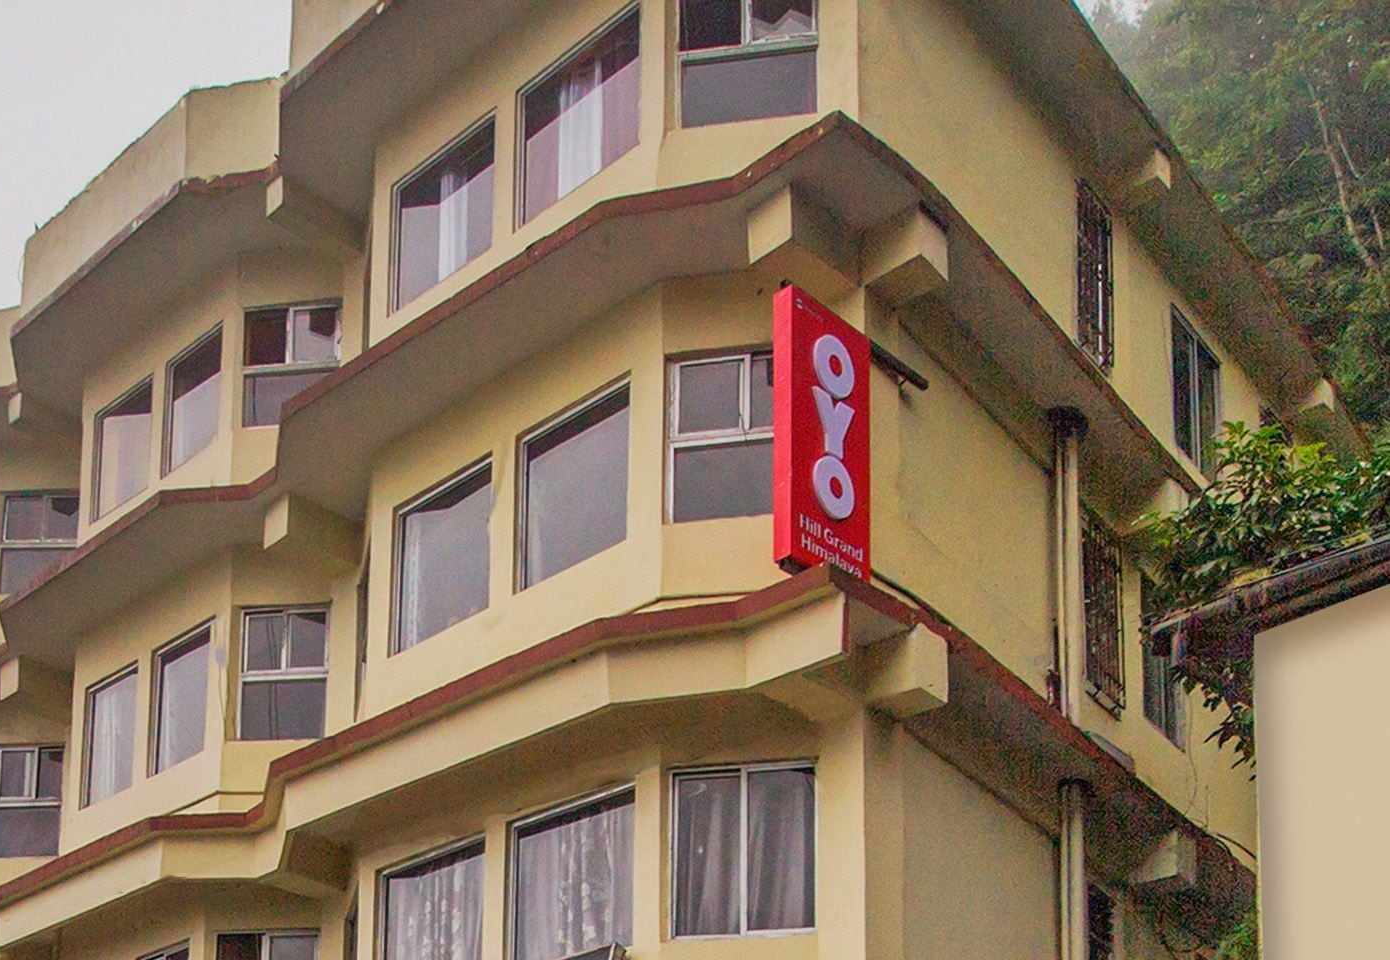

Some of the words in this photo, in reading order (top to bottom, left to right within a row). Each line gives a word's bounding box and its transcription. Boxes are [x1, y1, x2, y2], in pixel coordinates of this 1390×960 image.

[812, 334, 855, 520] OYO
[799, 513, 822, 538] Hill
[823, 527, 864, 562] Grand
[801, 533, 863, 579] Himalaya
